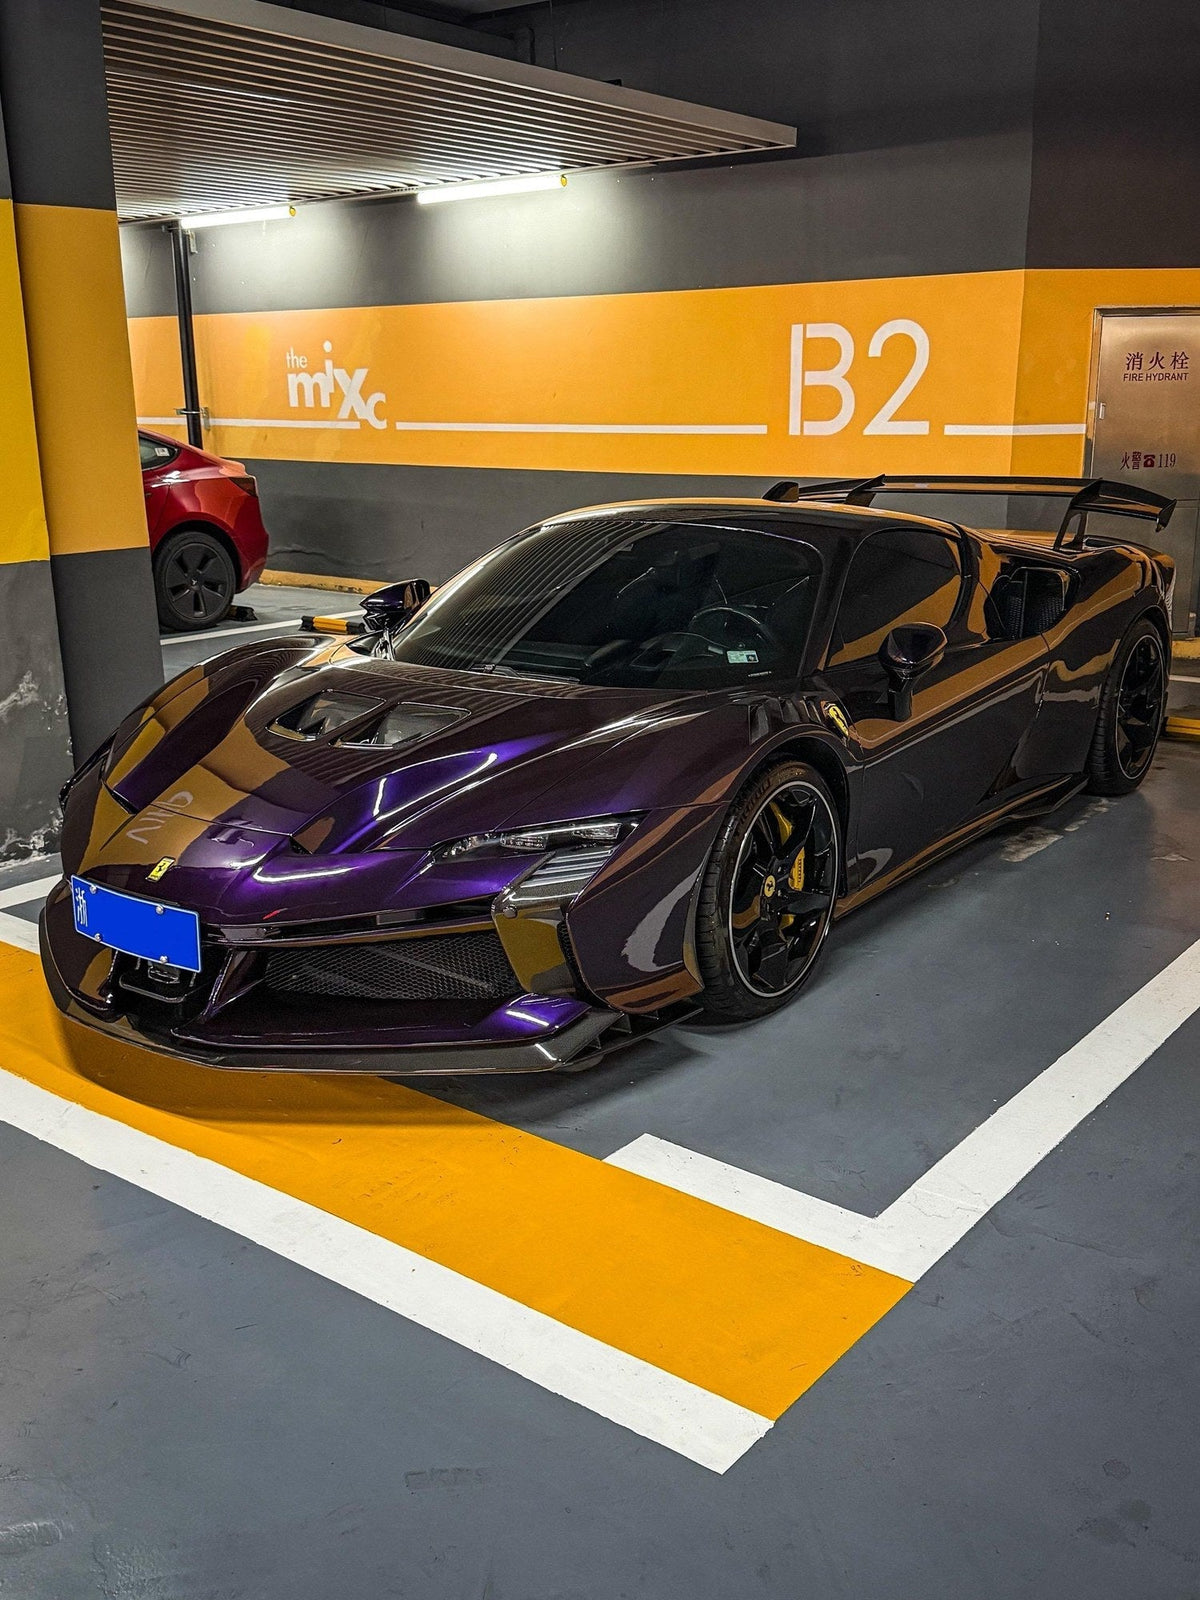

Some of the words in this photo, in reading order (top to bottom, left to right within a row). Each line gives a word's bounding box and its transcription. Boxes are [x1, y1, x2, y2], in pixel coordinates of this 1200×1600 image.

[286, 347, 308, 369] the
[1125, 351, 1190, 371] 消火栓
[788, 318, 930, 436] B2
[1123, 373, 1144, 382] FIRE
[1145, 372, 1189, 381] HYDRANT
[1158, 453, 1177, 468] 119
